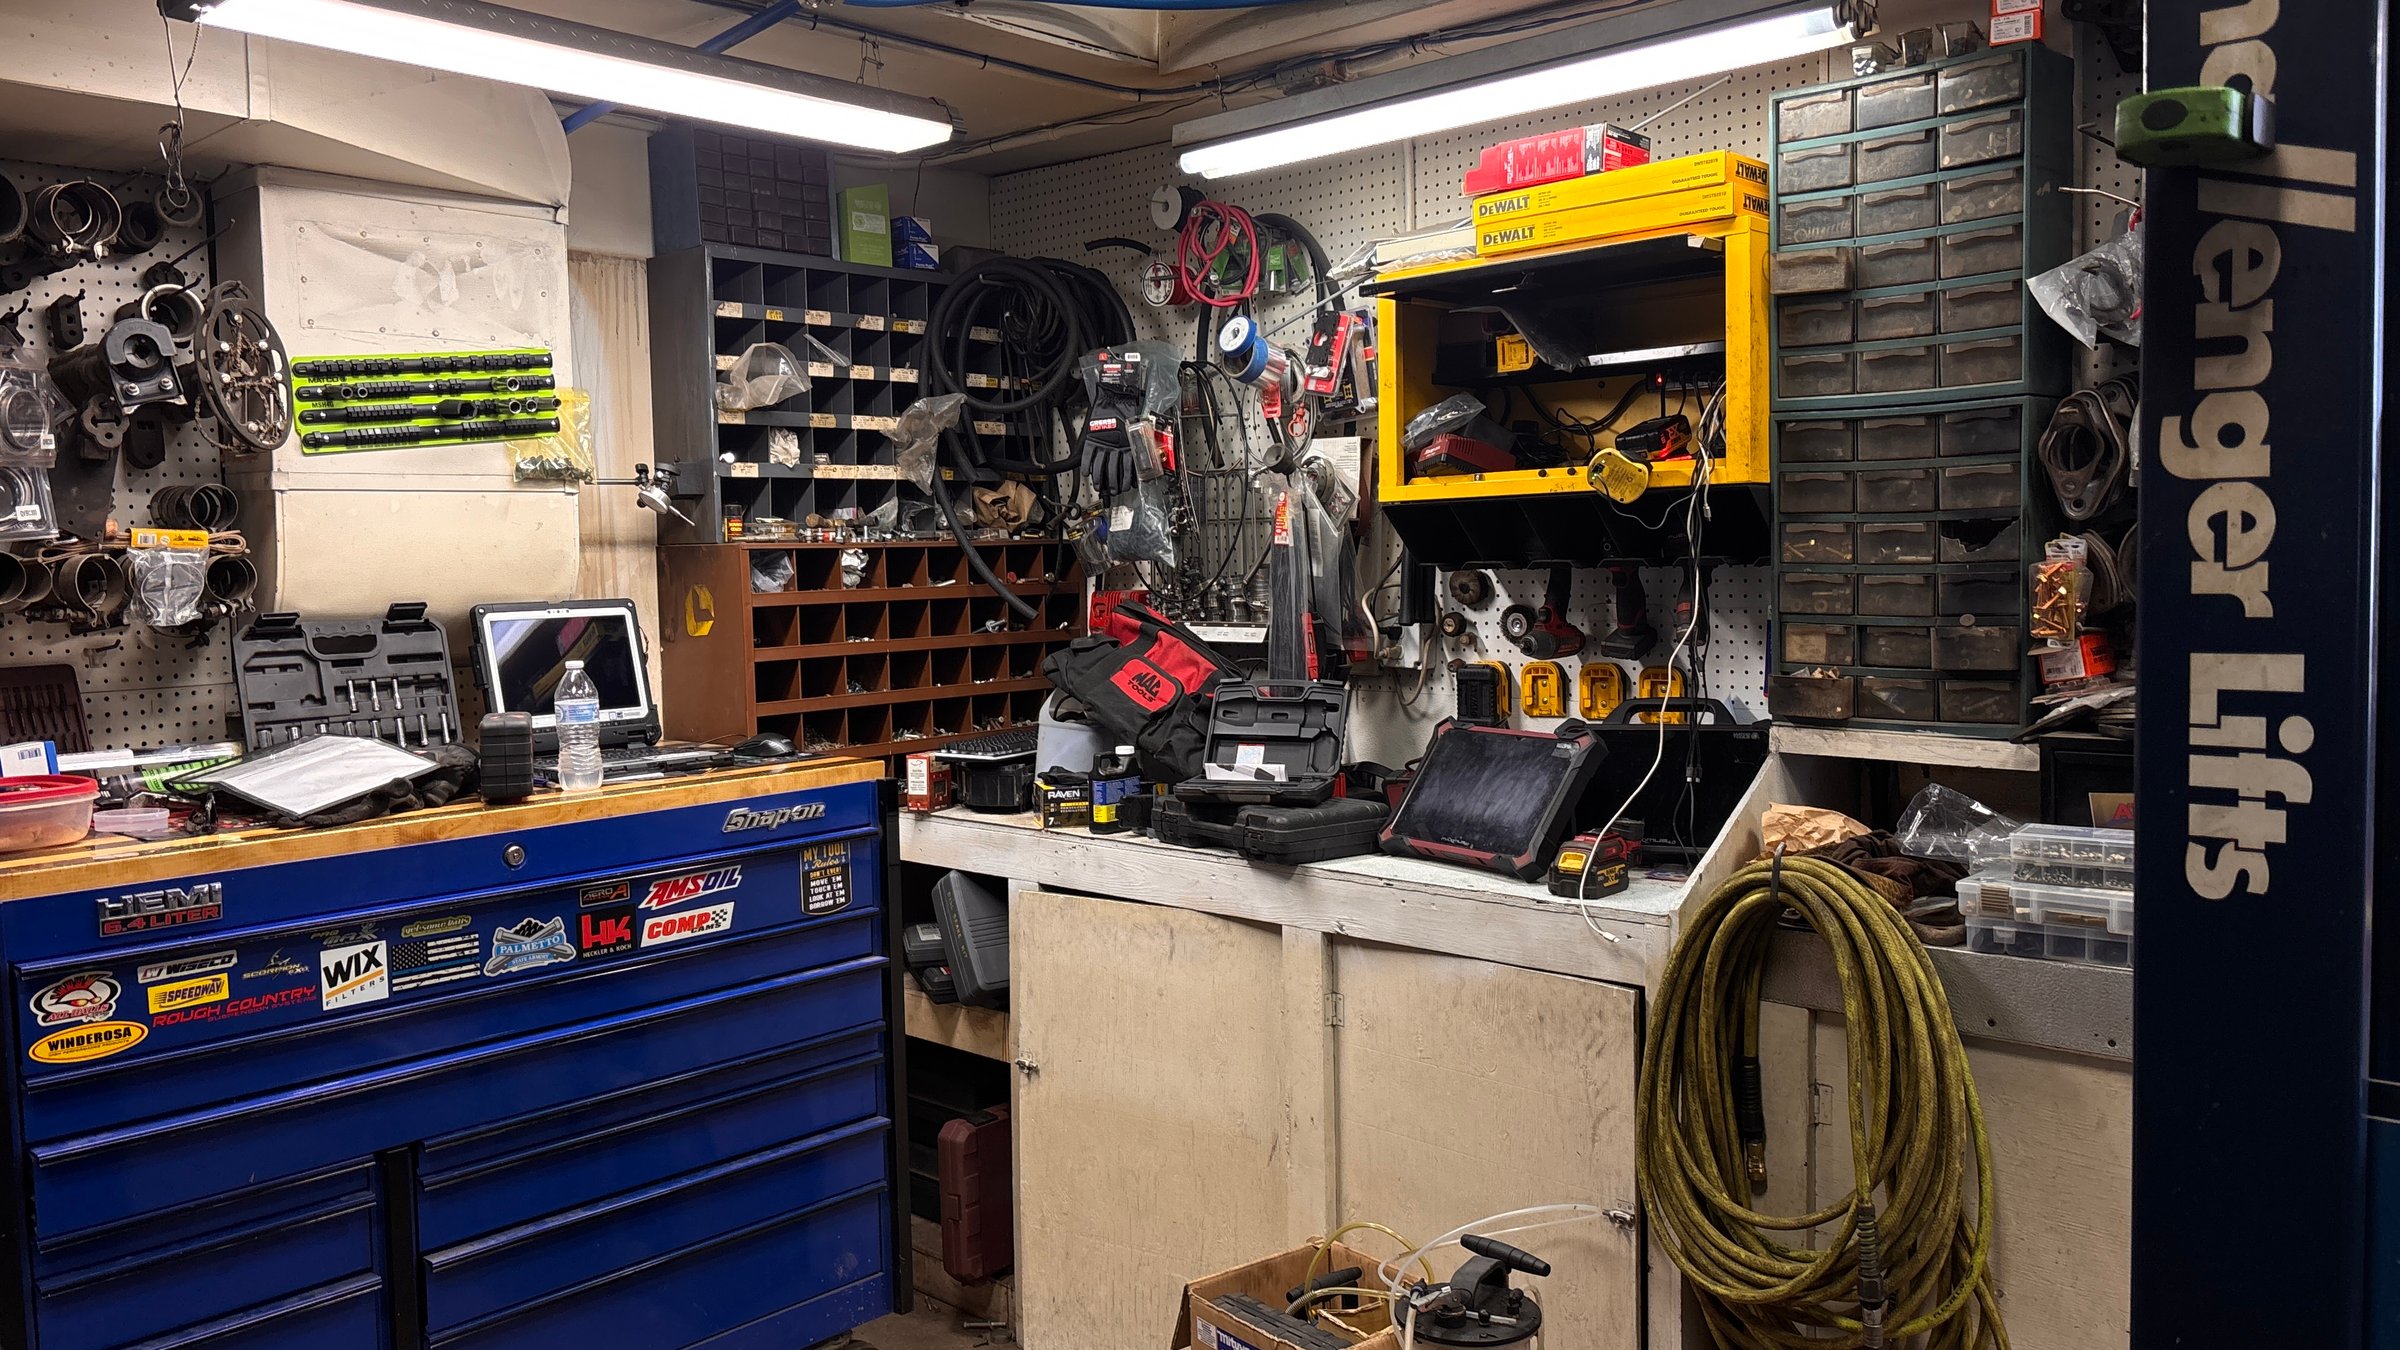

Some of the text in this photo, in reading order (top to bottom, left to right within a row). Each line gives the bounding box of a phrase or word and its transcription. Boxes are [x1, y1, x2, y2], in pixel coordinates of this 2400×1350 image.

[1671, 175, 1701, 185] GUARANTEED
[1735, 162, 1768, 184] DEWALT
[1479, 196, 1530, 217] DEWALT
[1679, 208, 1709, 217] GUARANTEED
[1483, 226, 1535, 247] DEWALT
[1127, 679, 1156, 703] TOOLS
[1131, 672, 1161, 698] MAC
[2185, 653, 2315, 899] Lifts
[1047, 789, 1080, 800] RAVEN
[1048, 817, 1055, 826] 7
[803, 841, 847, 863] MY TOOL
[811, 857, 840, 869] Rules
[645, 868, 740, 907] AMSOIL
[810, 877, 828, 888] MOVE
[810, 884, 831, 895] TOUCH
[97, 881, 222, 919] HEMI
[809, 894, 824, 903] LOOK
[809, 899, 834, 911] BORROW
[104, 905, 220, 935] 6.4 LITER
[647, 911, 712, 940] COMP
[690, 922, 722, 934] CAMS
[581, 914, 631, 949] HK
[500, 936, 560, 954] PALMETTO
[582, 948, 608, 959] HECKLER
[615, 943, 632, 952] KOCH
[166, 953, 235, 976] WISECO
[241, 963, 301, 980] SCORPION
[323, 944, 384, 989] WIX
[167, 979, 224, 1003] SPEEDWAY
[325, 975, 385, 1007] FILTERS
[152, 985, 318, 1028] ROUGH COUNTRY
[207, 1005, 269, 1023] SUSPENSION
[47, 1026, 132, 1052] WINDEROSA
